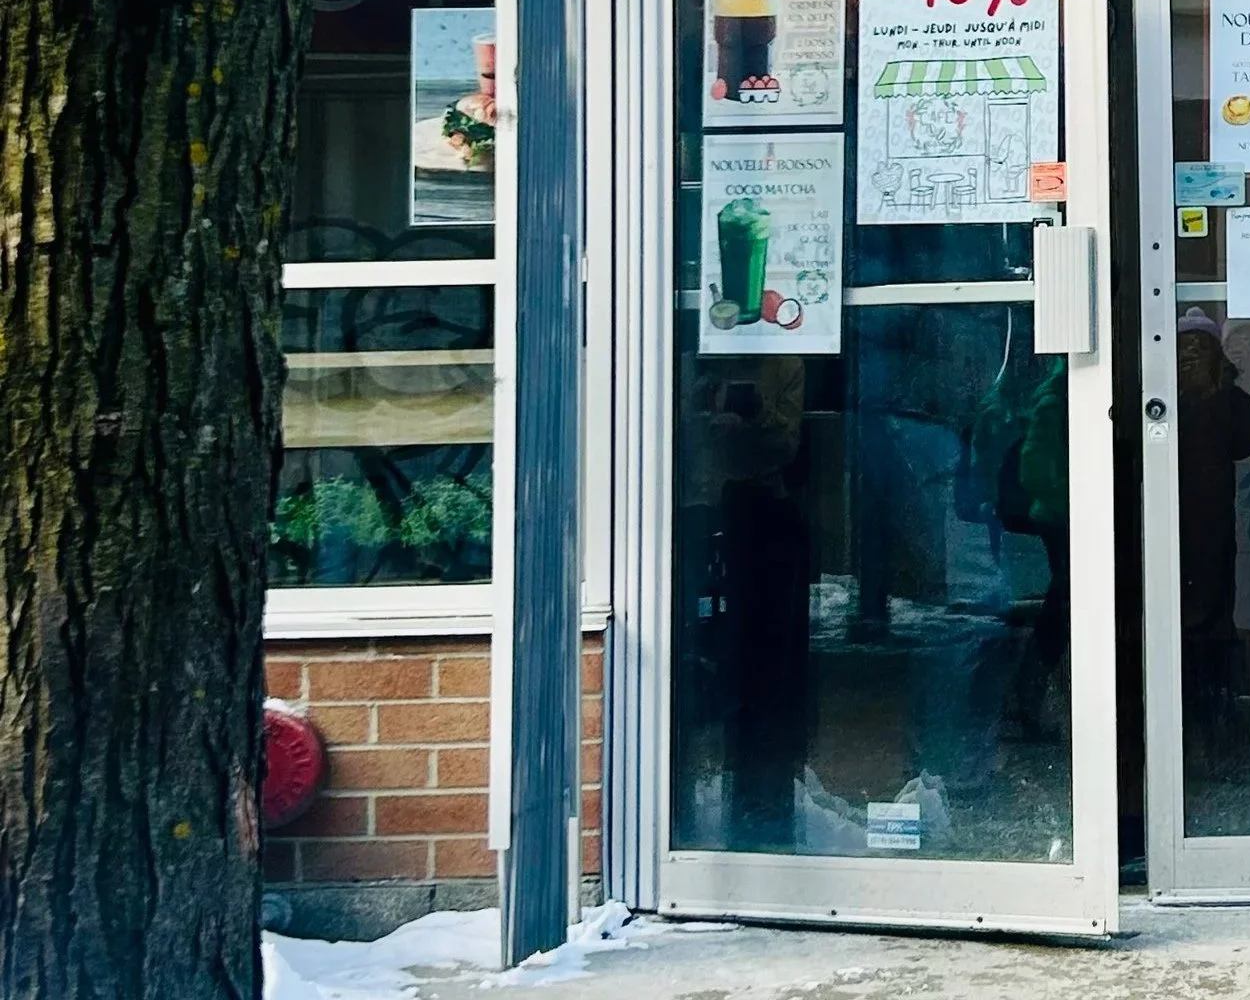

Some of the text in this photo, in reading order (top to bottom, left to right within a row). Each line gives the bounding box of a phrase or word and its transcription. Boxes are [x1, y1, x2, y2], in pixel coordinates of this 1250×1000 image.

[873, 25, 909, 36] LUNDI
[923, 23, 957, 34] JEUDI
[1021, 21, 1046, 32] MIDI
[897, 39, 918, 49] MON
[965, 37, 992, 47] UNTIL
[995, 36, 1022, 46] NOON
[711, 158, 833, 171] NOUVELLE BOISSON
[725, 184, 816, 195] COCO MATCHA
